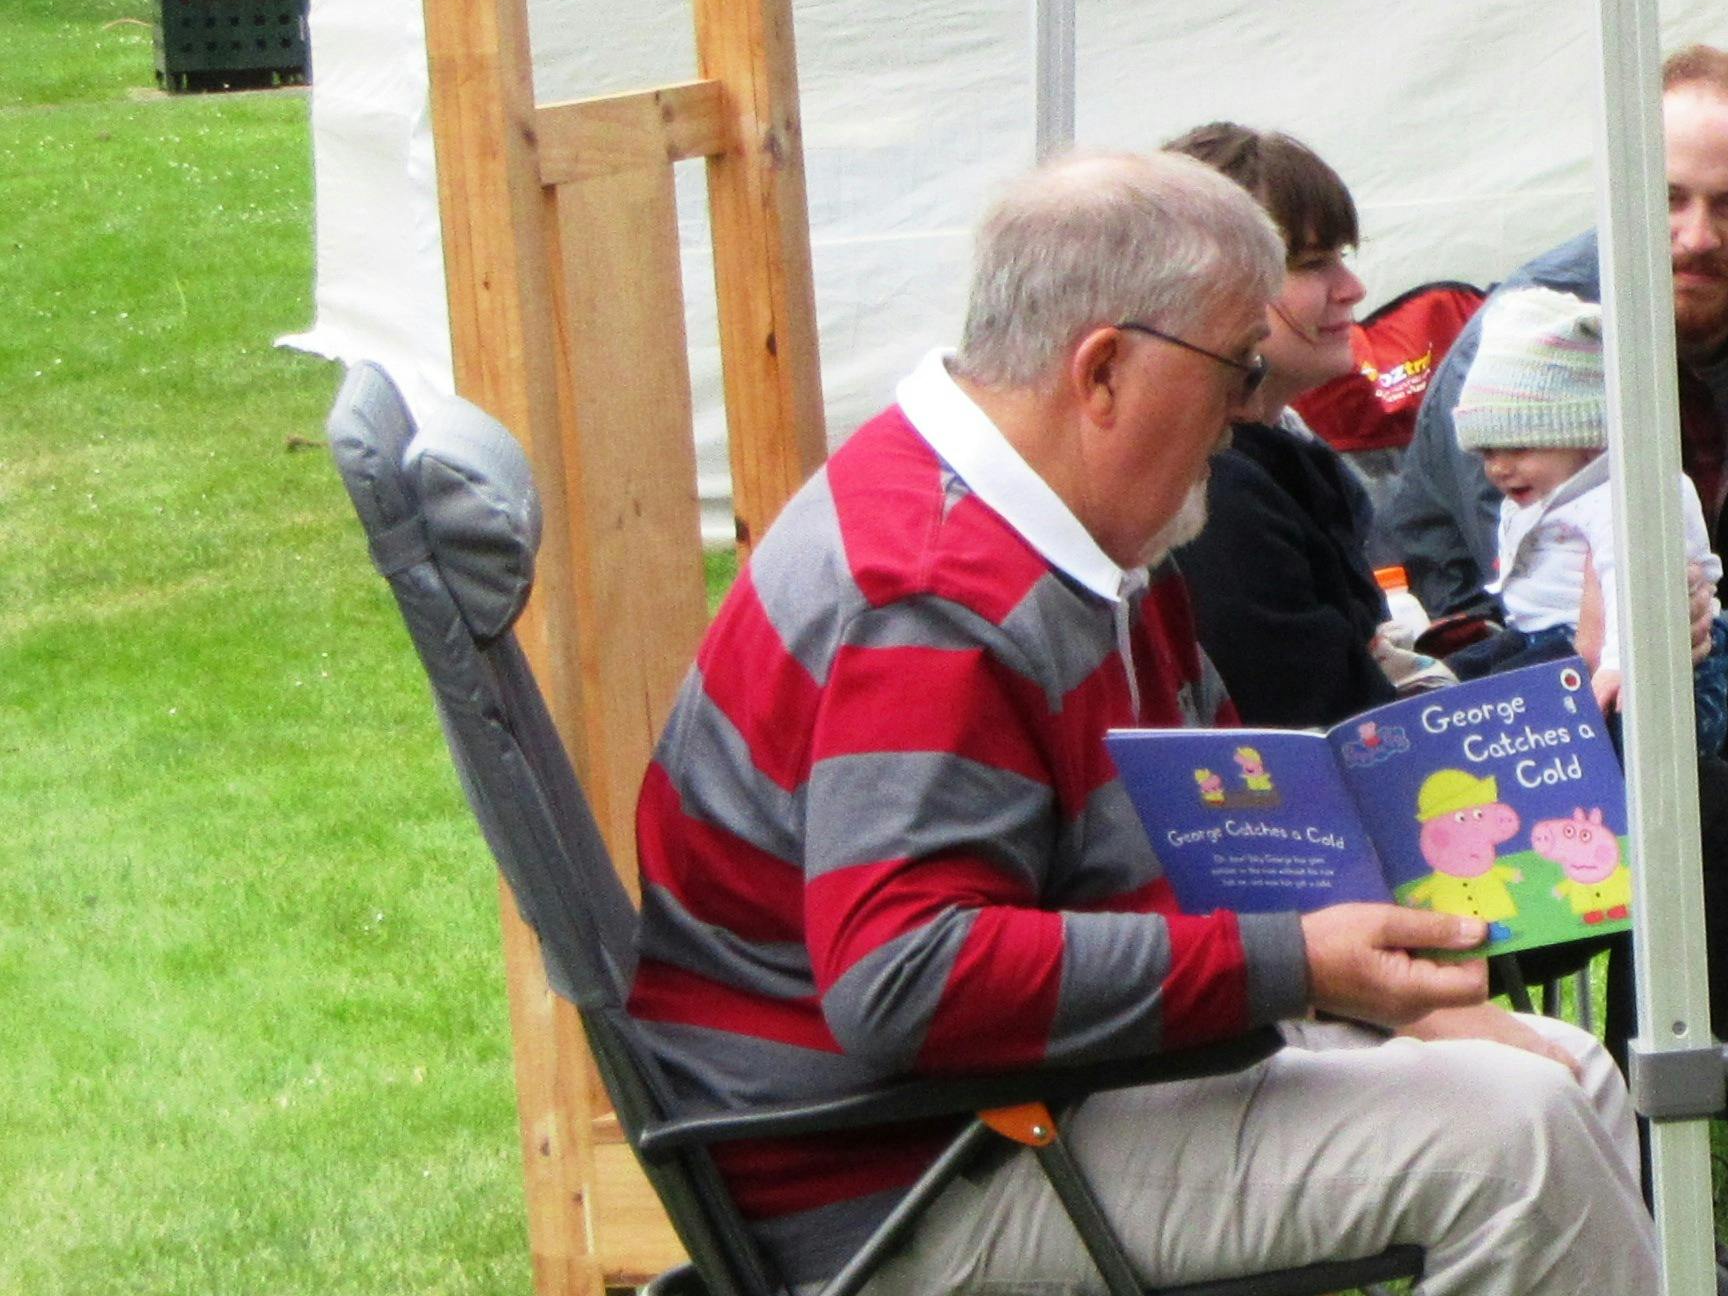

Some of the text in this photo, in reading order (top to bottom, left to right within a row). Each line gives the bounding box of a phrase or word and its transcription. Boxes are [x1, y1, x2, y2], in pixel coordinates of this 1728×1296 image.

[1421, 693, 1526, 735] George
[1462, 724, 1596, 763] Catches a
[1515, 755, 1584, 789] Cold
[1167, 828, 1223, 847] George
[1225, 820, 1288, 839] Catches
[1306, 826, 1345, 850] Cold
